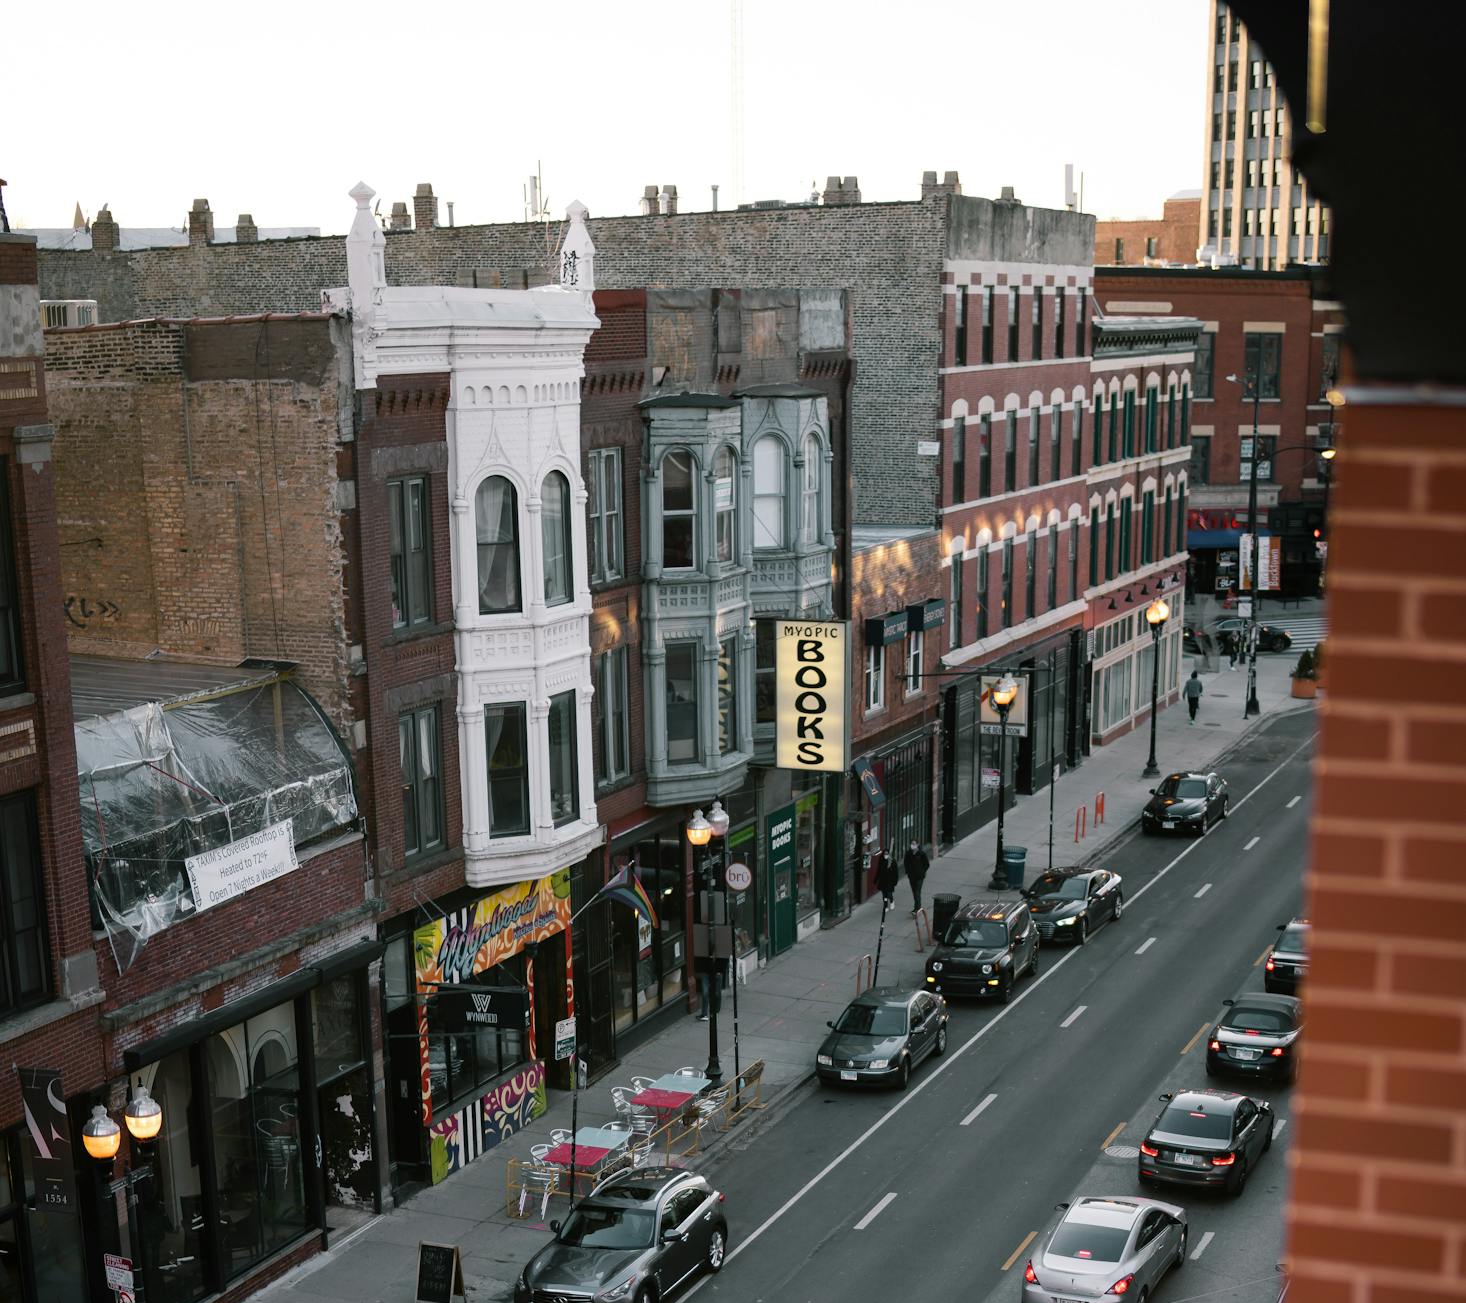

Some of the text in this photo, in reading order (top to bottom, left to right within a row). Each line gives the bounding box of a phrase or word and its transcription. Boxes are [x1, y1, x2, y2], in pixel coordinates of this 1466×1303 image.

[784, 626, 838, 638] MYOPIC
[795, 639, 827, 765] BOOKS
[771, 817, 792, 837] MYOPIC
[221, 841, 250, 858] Covered
[250, 831, 277, 847] Rooftop
[277, 827, 285, 837] is
[772, 832, 791, 850] BOOKS
[220, 859, 243, 878] Heated
[245, 859, 253, 869] to
[209, 888, 228, 902] Open
[234, 876, 256, 893] Nights
[437, 879, 541, 982] Wynwood
[465, 1011, 498, 1024] WYNWOOD
[45, 1193, 67, 1205] 1554
